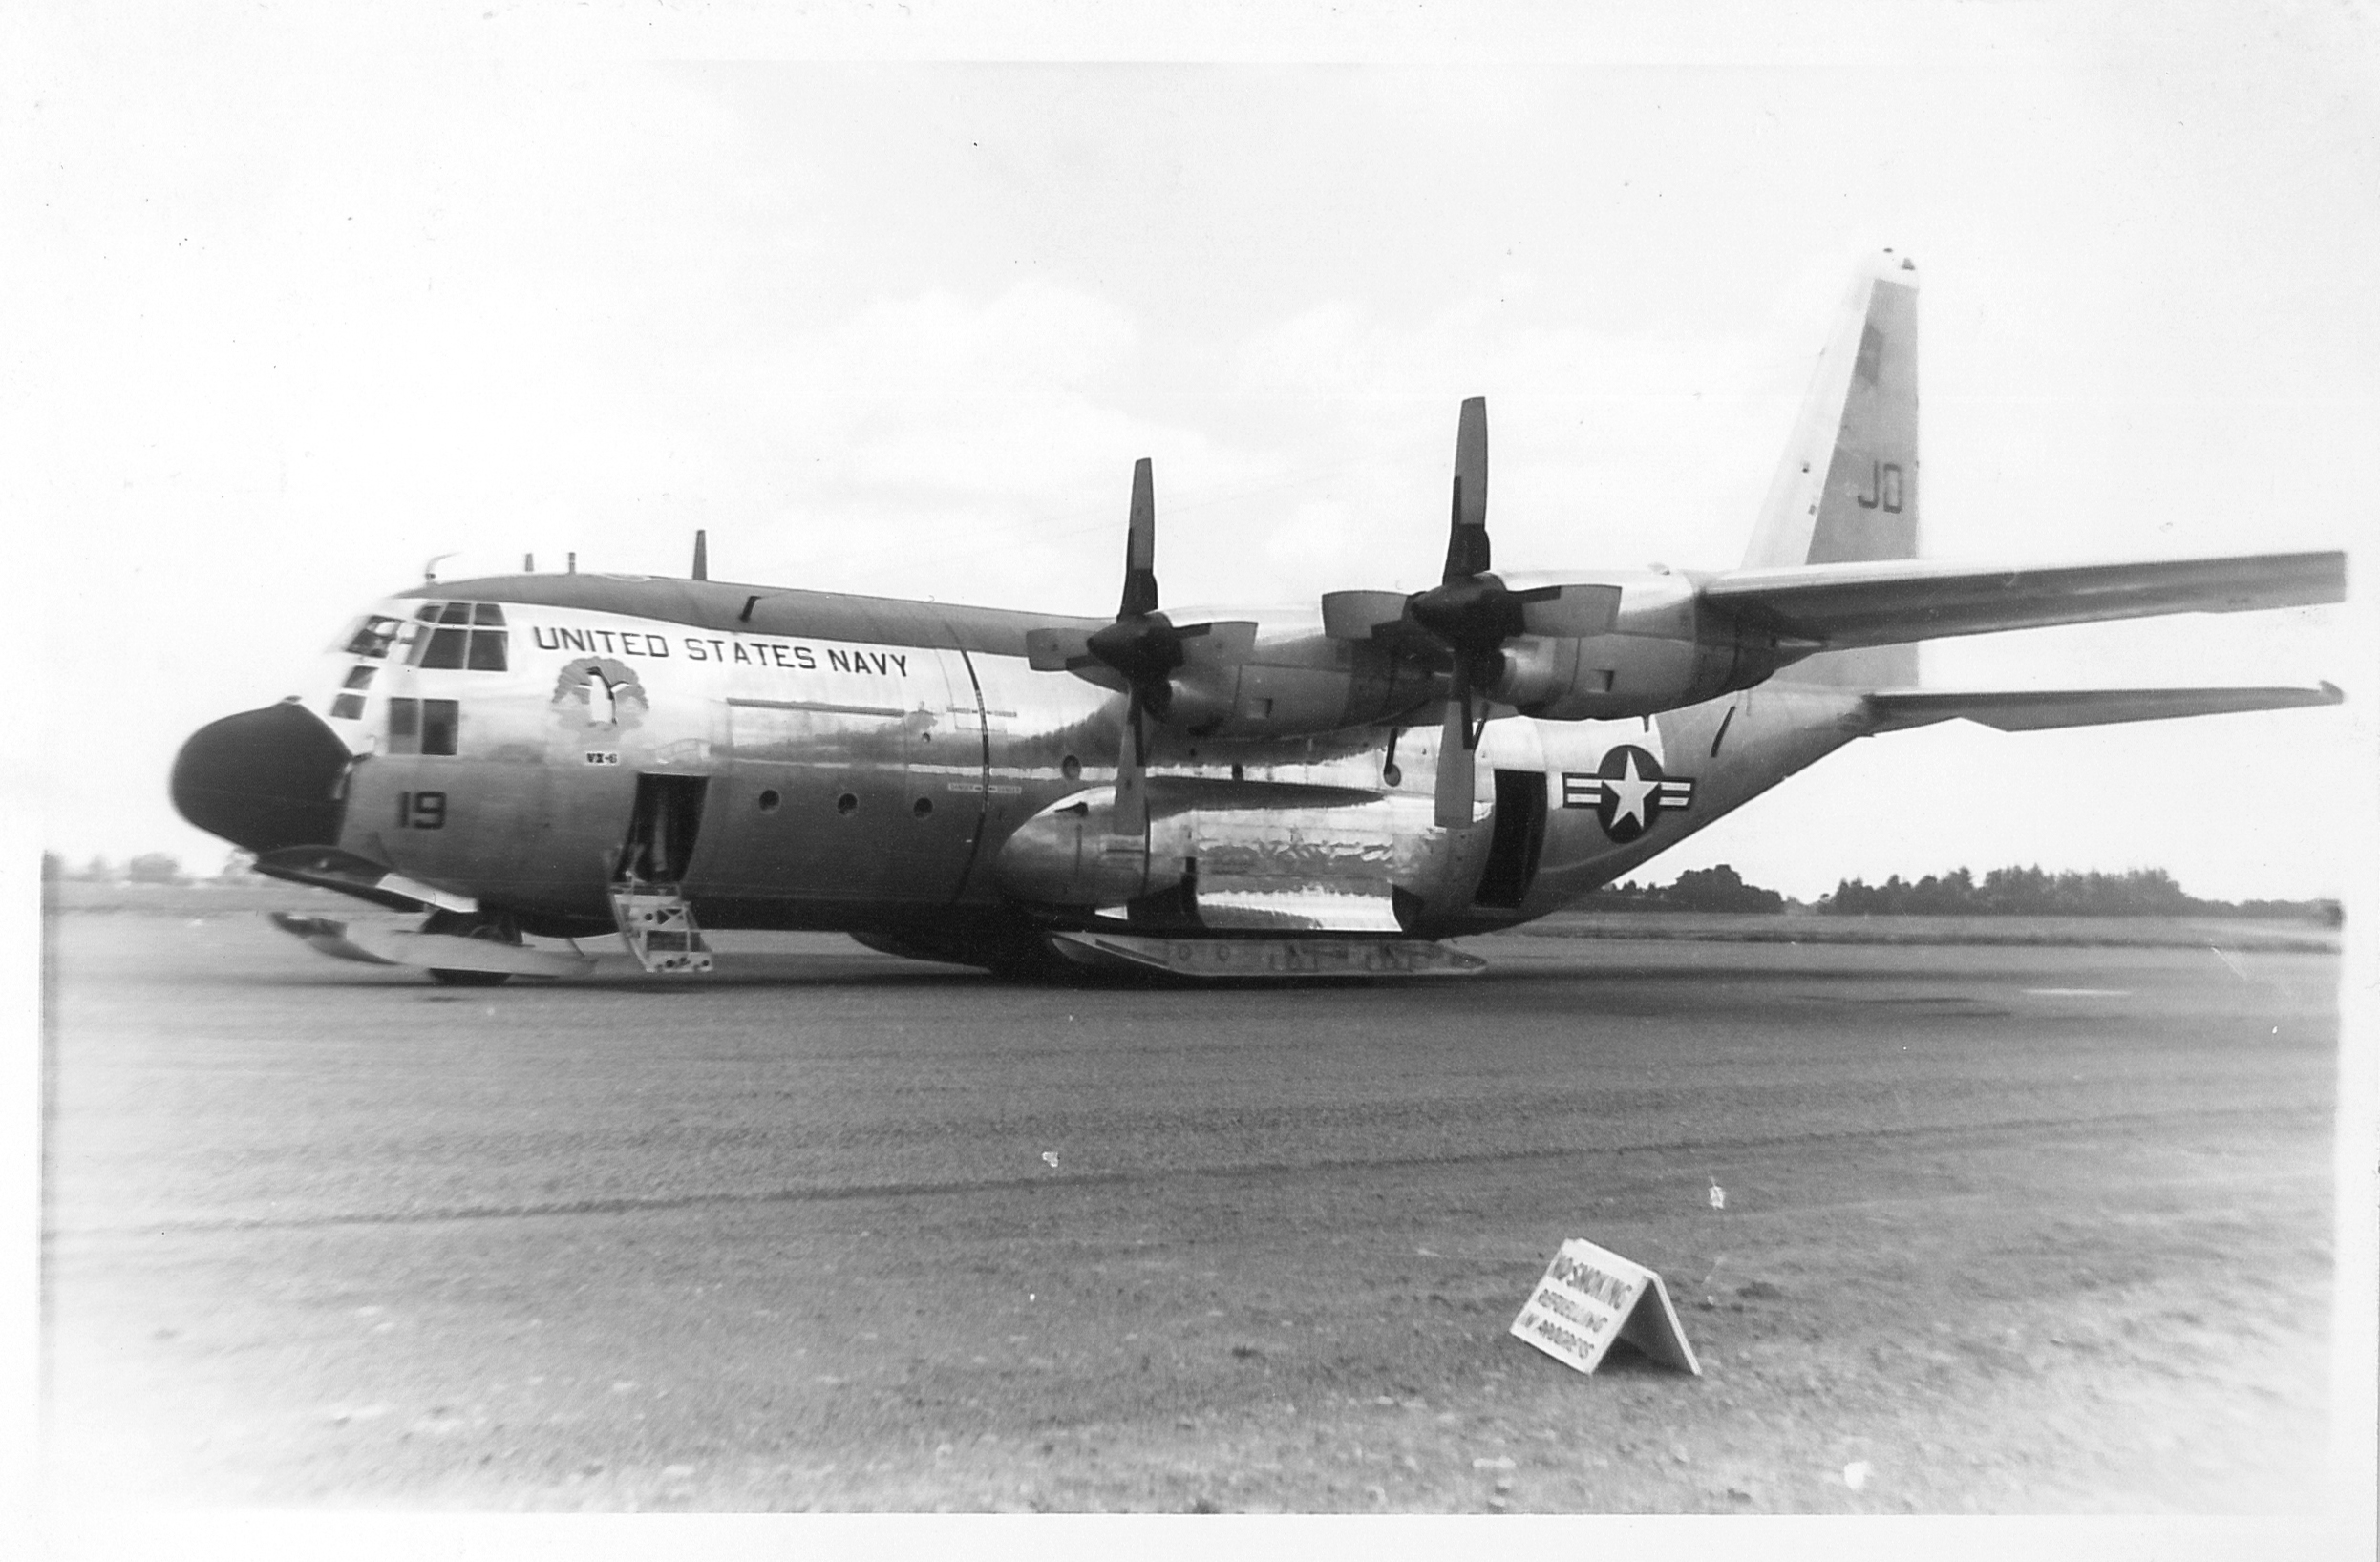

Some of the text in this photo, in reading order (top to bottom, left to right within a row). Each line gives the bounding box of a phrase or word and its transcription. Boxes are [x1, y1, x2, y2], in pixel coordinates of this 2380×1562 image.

[1857, 459, 1903, 514] JD
[532, 625, 909, 678] UNITED STATES NAVY
[586, 752, 618, 764] VX-6
[399, 791, 447, 830] 19
